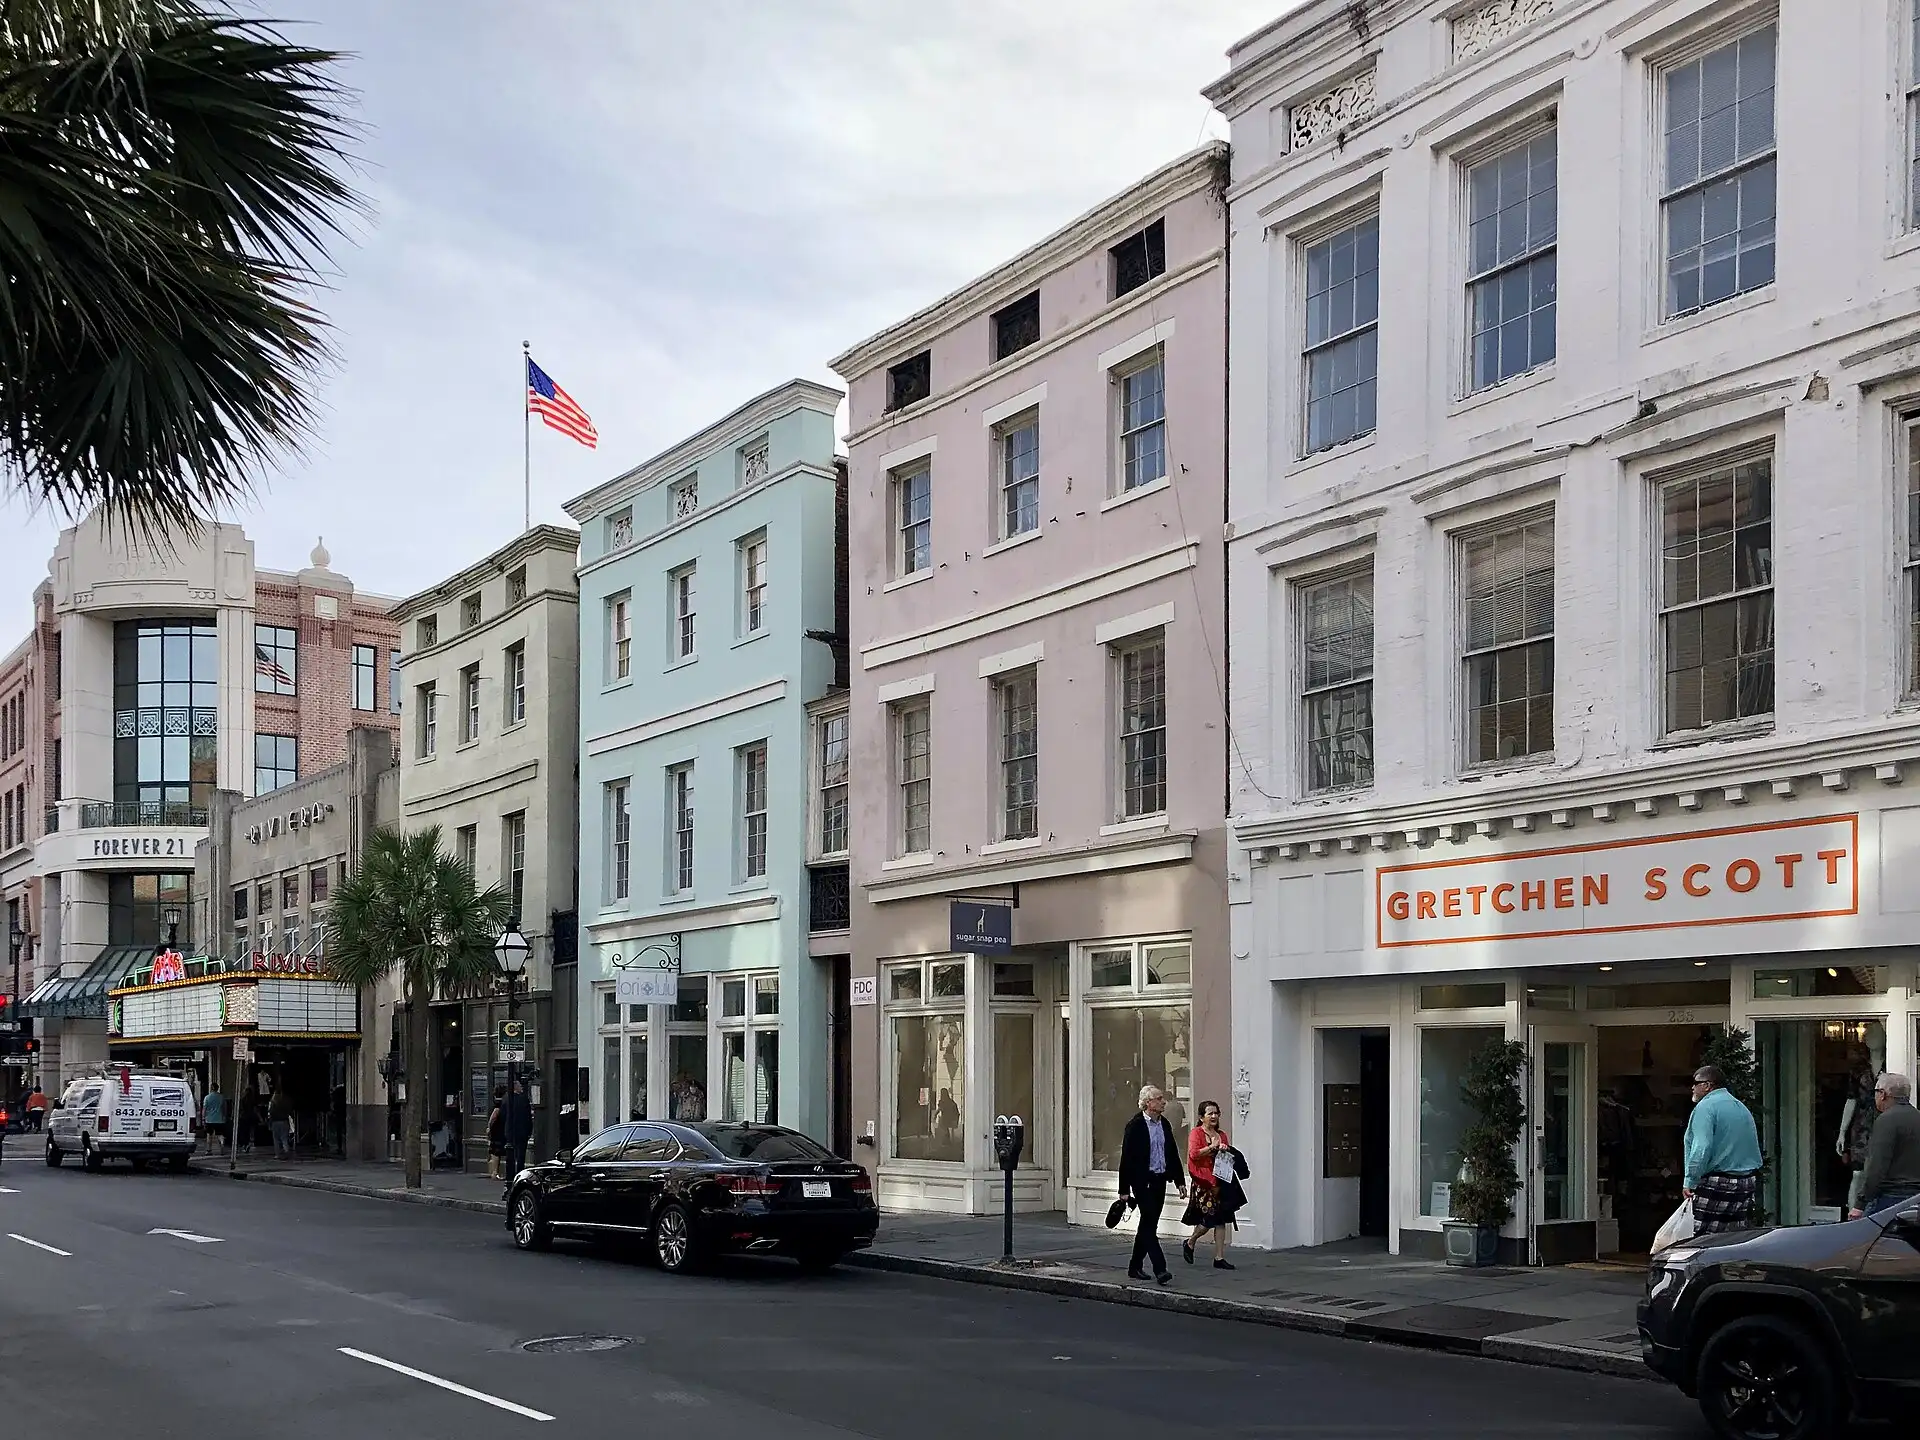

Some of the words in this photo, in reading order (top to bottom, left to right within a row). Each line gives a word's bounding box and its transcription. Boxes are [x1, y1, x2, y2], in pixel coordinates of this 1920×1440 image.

[250, 802, 325, 844] RIVIERA
[94, 838, 160, 855] FOREVER
[166, 838, 184, 855] 21
[1387, 873, 1609, 921] GRETCHEN
[1644, 849, 1847, 901] SCOTT
[956, 933, 975, 942] sugar
[976, 935, 993, 943] snap
[994, 936, 1007, 944] pea
[853, 980, 873, 994] FDC
[115, 1108, 185, 1117] 843.766.6890
